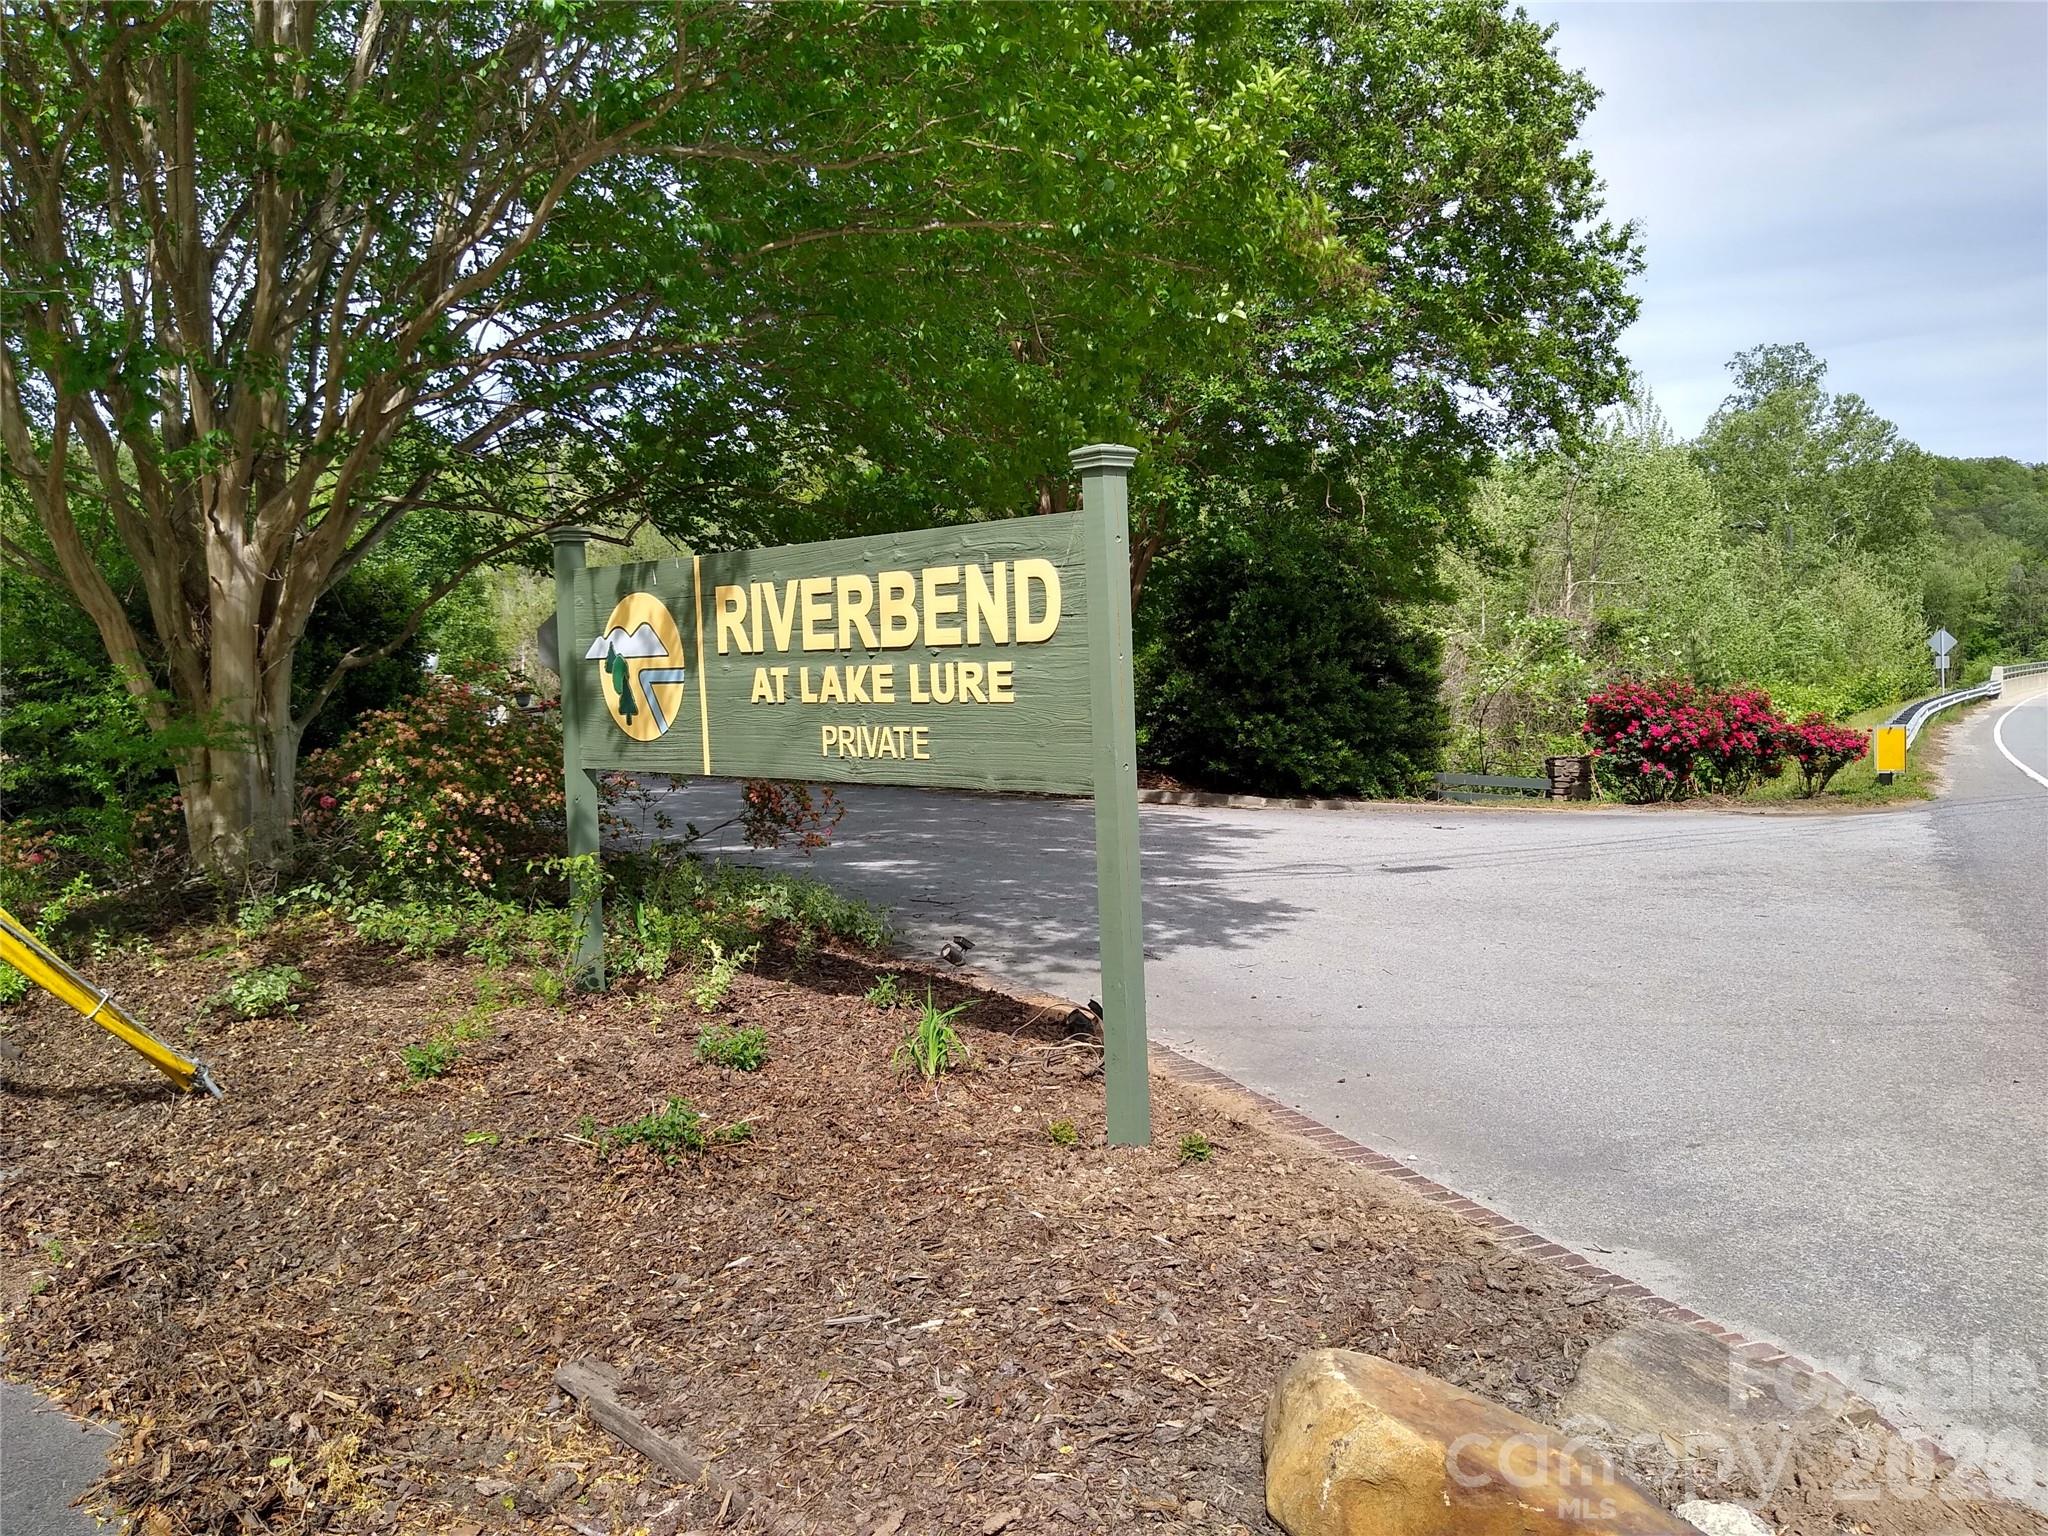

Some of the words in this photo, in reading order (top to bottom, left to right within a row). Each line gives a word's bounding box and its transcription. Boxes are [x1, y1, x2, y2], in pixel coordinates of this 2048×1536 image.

[715, 558, 1062, 655] RIVERBEND
[751, 667, 790, 704] AT
[800, 664, 896, 704] LAKE
[909, 661, 1016, 704] LURE
[822, 725, 931, 760] PRIVATE
